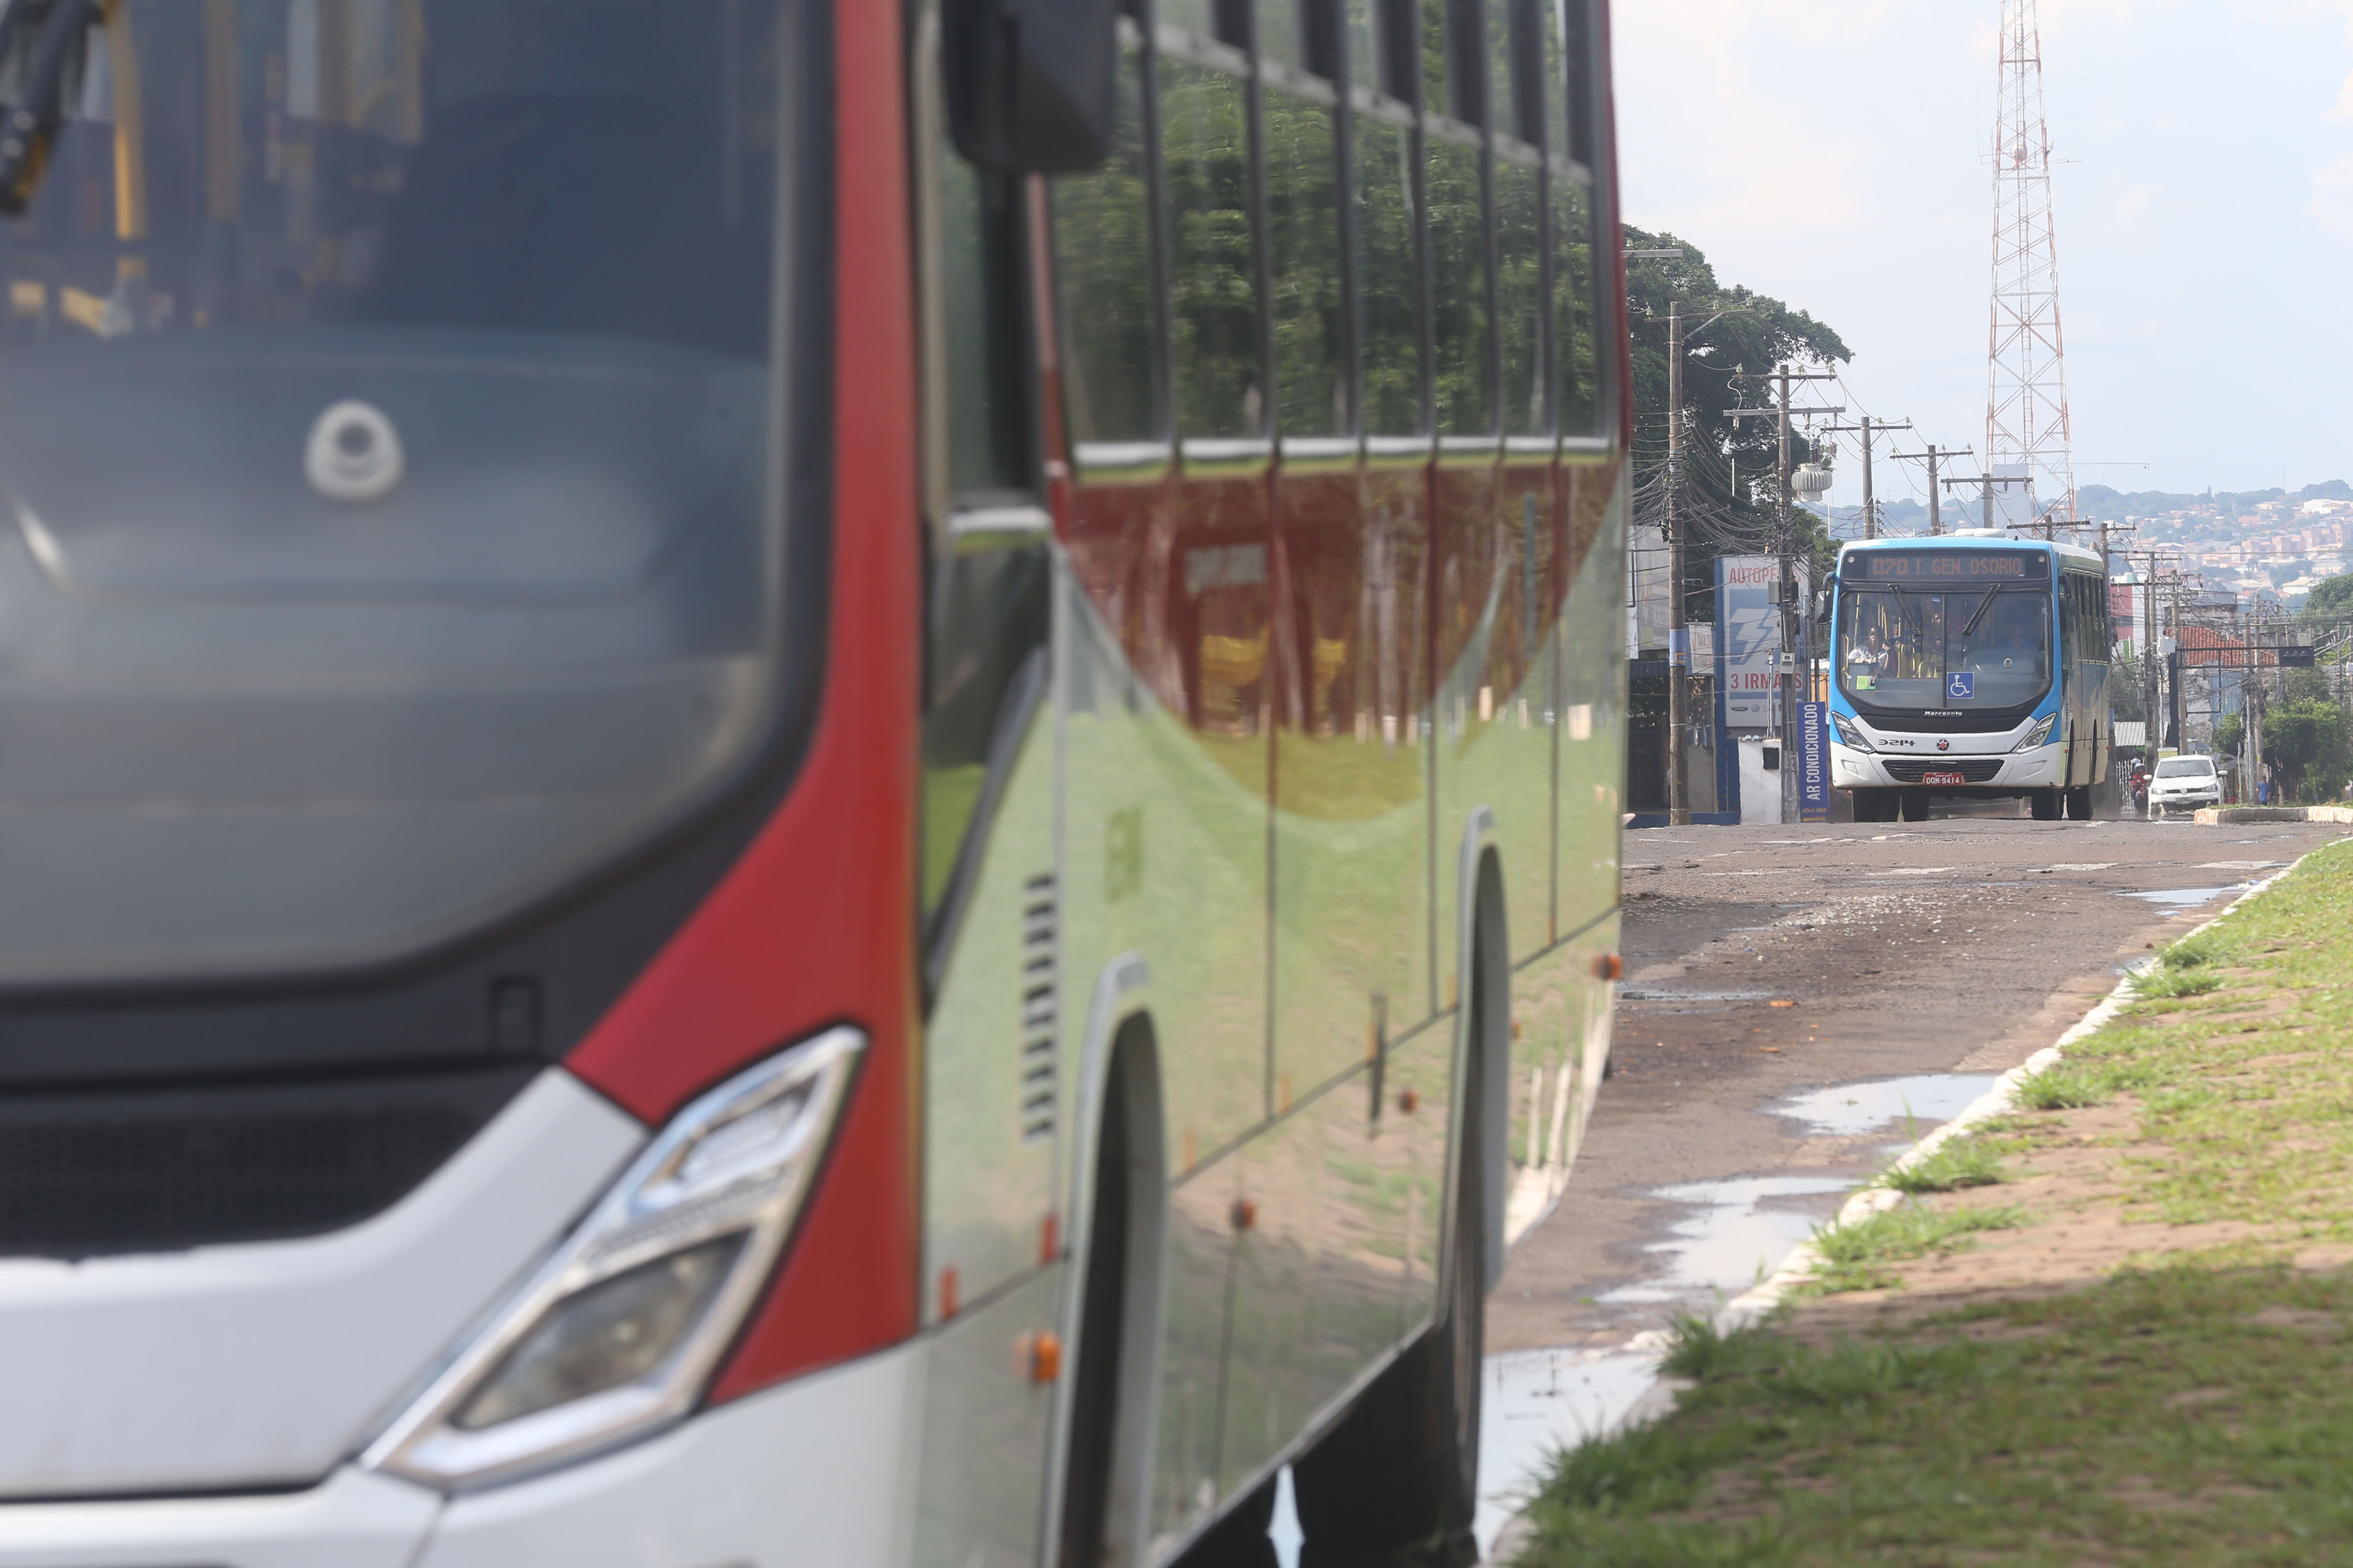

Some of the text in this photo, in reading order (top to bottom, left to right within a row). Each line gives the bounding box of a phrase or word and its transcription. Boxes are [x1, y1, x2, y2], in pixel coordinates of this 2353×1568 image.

[1729, 567, 1802, 583] AUTOPES
[1872, 558, 2022, 575] 070 T. GEN. OSORIO
[1731, 670, 1802, 689] 3 IRMÃS
[1803, 704, 1820, 783] CONDICIONADO
[1807, 785, 1820, 800] AR
